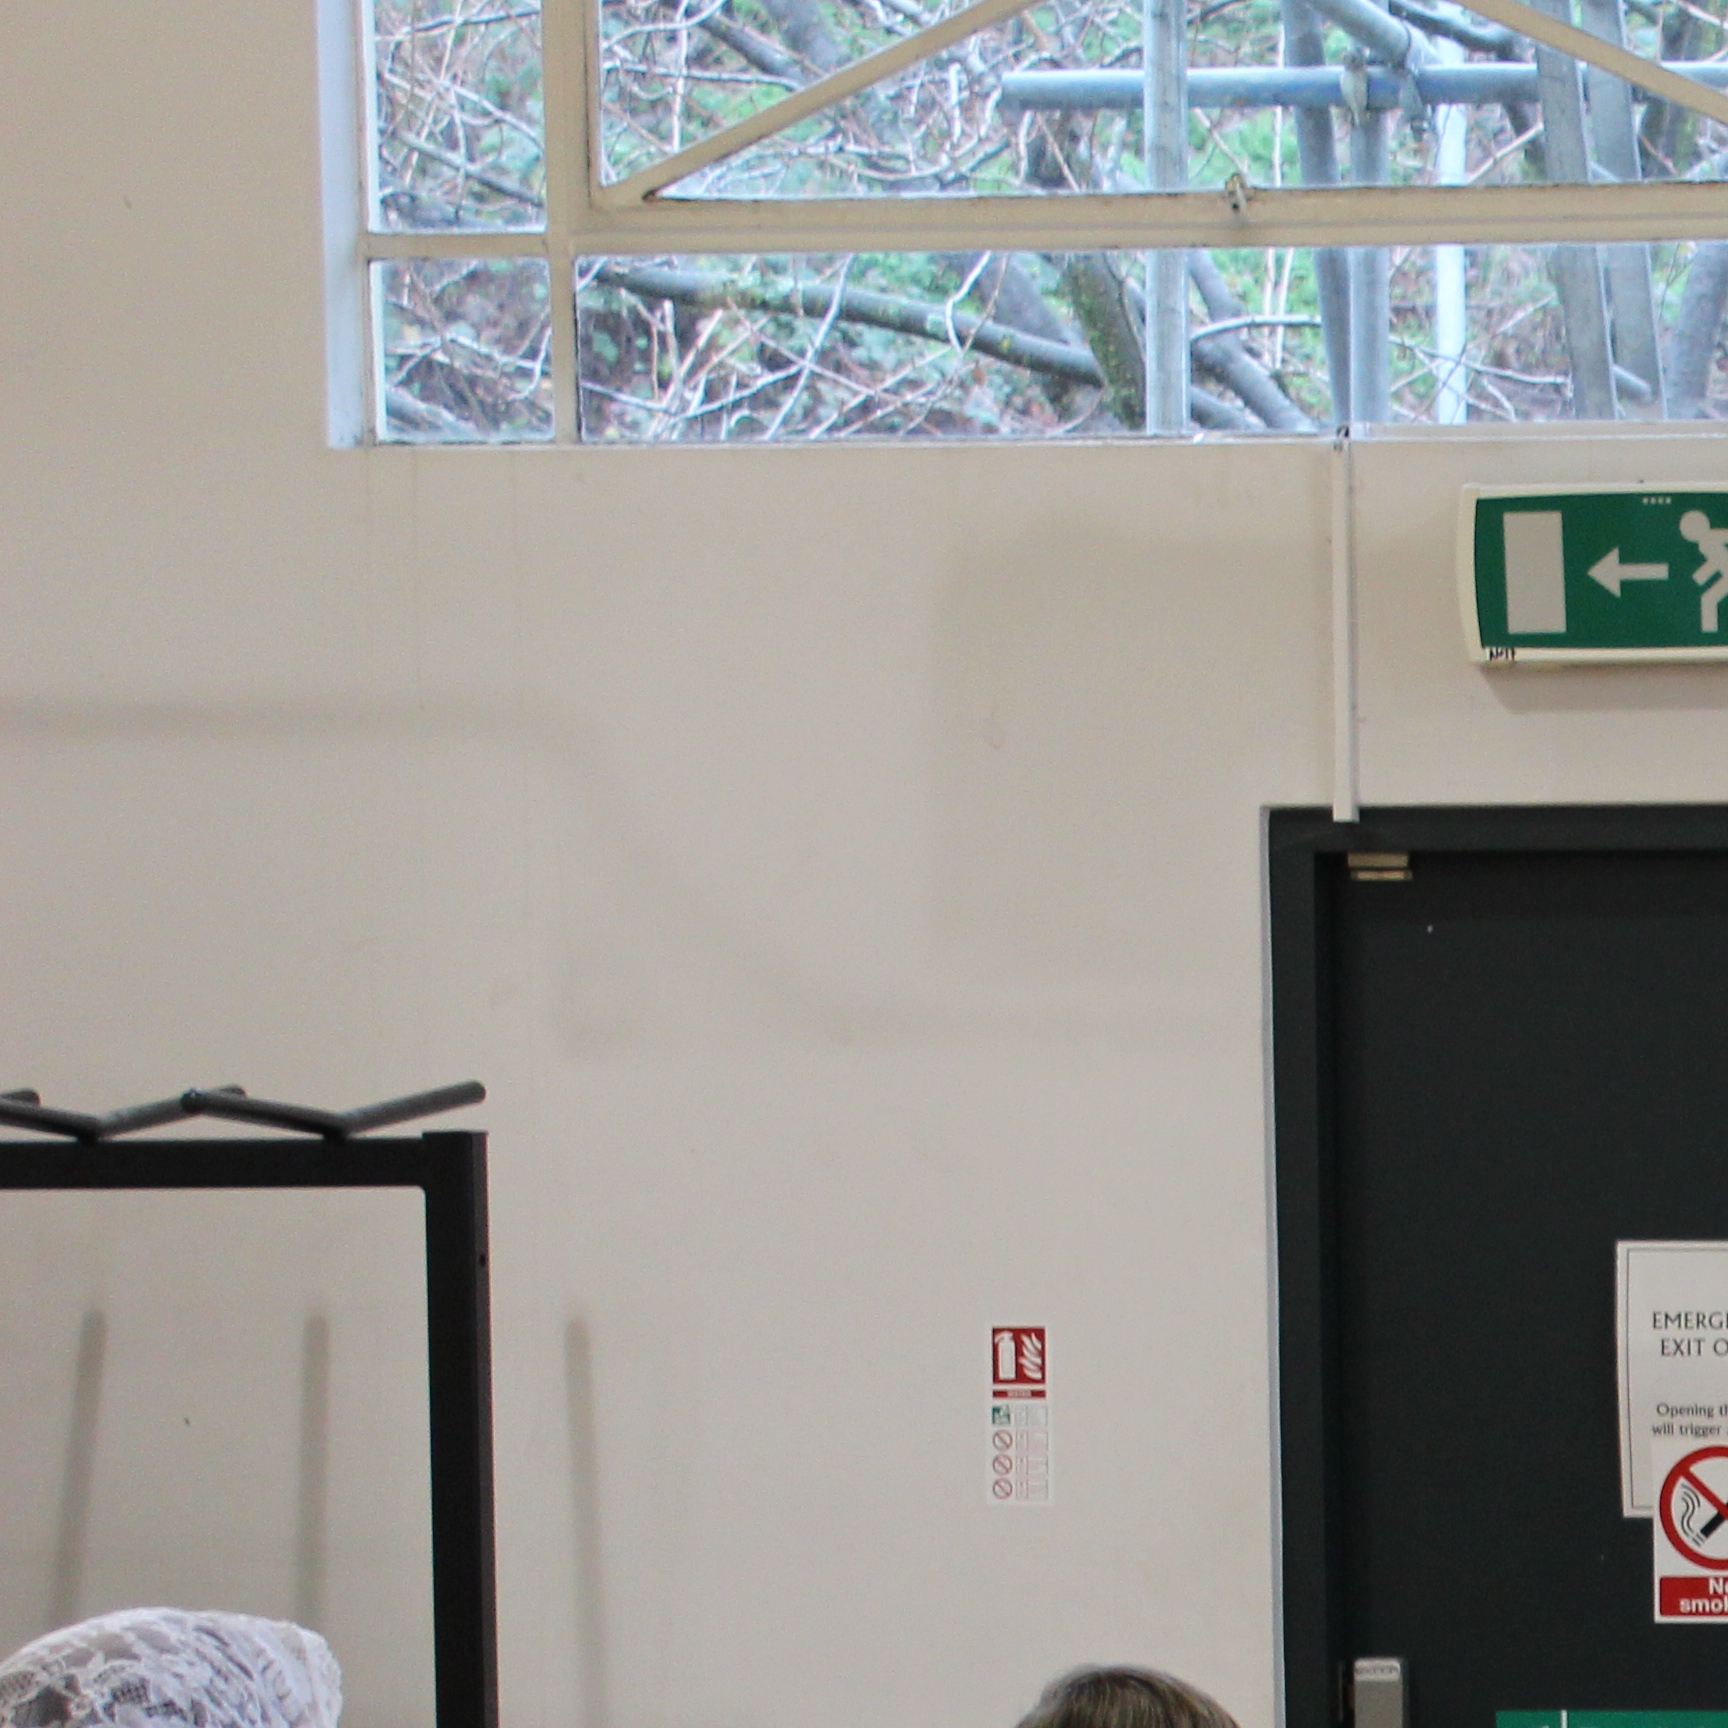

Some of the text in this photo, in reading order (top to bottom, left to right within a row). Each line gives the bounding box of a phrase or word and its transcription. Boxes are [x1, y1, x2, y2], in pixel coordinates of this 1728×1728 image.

[1661, 1338, 1706, 1357] EXIT
[1656, 1402, 1714, 1418] Opening
[1652, 1422, 1675, 1436] will
[1679, 1422, 1722, 1438] trigger
